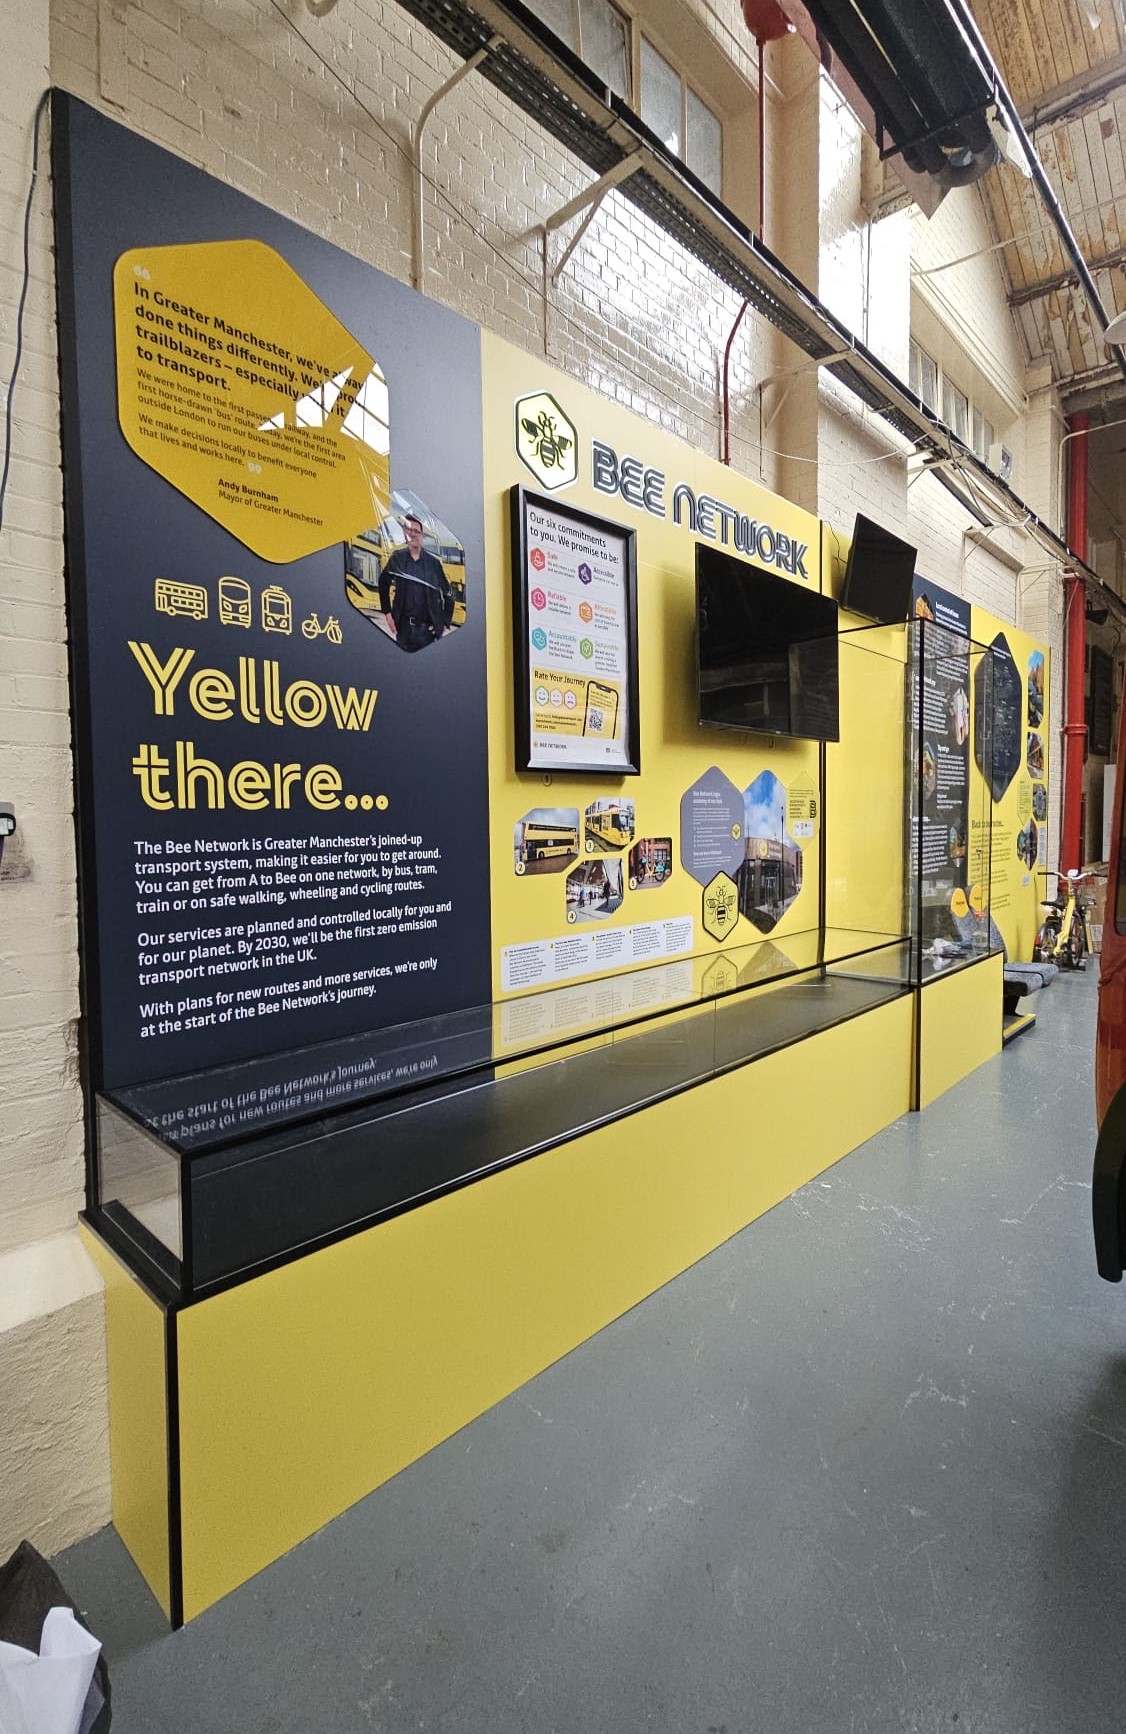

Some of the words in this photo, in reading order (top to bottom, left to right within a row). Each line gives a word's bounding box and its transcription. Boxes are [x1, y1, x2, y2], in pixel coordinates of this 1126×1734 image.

[135, 282, 149, 300] In
[153, 291, 210, 325] Greater
[213, 317, 293, 362] Manchester,
[296, 355, 330, 376] we've
[135, 304, 174, 330] done
[177, 322, 223, 351] things
[226, 343, 298, 382] differently.
[136, 325, 222, 368] trailblazers
[236, 366, 300, 402] especially
[136, 345, 153, 361] to
[157, 353, 231, 391] transport.
[137, 368, 151, 381] We
[153, 376, 175, 389] were
[177, 382, 201, 398] home
[202, 393, 212, 402] to
[213, 396, 227, 408] the
[229, 400, 244, 414] first
[137, 381, 157, 396] first
[158, 388, 213, 414] horse-drawn
[138, 395, 172, 413] outside
[174, 405, 206, 424] London
[207, 418, 217, 428] to
[218, 422, 231, 433] run
[233, 427, 247, 438] our
[248, 432, 270, 447] buses
[271, 440, 292, 454] under
[293, 448, 310, 460] local
[311, 454, 337, 469] control.
[138, 413, 153, 425] We
[155, 420, 179, 434] make
[181, 427, 220, 447] decisions
[221, 440, 246, 456] locally
[247, 449, 256, 459] to
[258, 451, 284, 468] benefit
[285, 463, 317, 479] everyone
[139, 426, 159, 440] that
[160, 432, 180, 446] lives
[181, 440, 198, 452] and
[199, 446, 223, 460] works
[225, 453, 245, 467] here.
[303, 440, 316, 451] the
[316, 444, 331, 456] first
[331, 450, 346, 461] area
[312, 433, 326, 444] and
[326, 437, 338, 448] the
[218, 477, 240, 493] Andy
[242, 485, 279, 503] Burnham
[218, 490, 242, 505] Mayor
[244, 496, 253, 507] of
[254, 500, 282, 515] Greater
[283, 508, 323, 526] Manchester
[591, 437, 666, 520] BEE
[672, 480, 809, 580] NETWORK
[529, 511, 544, 525] Our
[546, 518, 556, 530] six
[558, 524, 607, 548] commitments
[530, 527, 539, 537] to
[540, 530, 556, 542] you.
[558, 533, 570, 548] We
[571, 541, 599, 559] promise
[600, 551, 608, 561] to
[608, 552, 619, 564] be:
[127, 640, 379, 731] Yellow
[534, 670, 549, 681] Rate
[549, 672, 563, 682] Your
[564, 675, 586, 688] Journey
[132, 740, 389, 811] there...
[134, 841, 162, 855] The
[165, 840, 191, 854] Bee
[194, 838, 250, 853] Network
[252, 838, 262, 851] is
[264, 837, 307, 850] Greater
[309, 834, 377, 849] Manchester's
[377, 834, 423, 849] joined-up
[134, 858, 201, 876] transport
[204, 857, 252, 874] system,
[255, 854, 298, 869] making
[300, 853, 309, 866] it
[310, 852, 343, 865] easier
[344, 852, 359, 864] for
[360, 853, 379, 865] you
[380, 851, 390, 862] to
[392, 850, 407, 864] get
[408, 847, 441, 861] around.
[135, 880, 162, 894] You
[165, 879, 190, 892] can
[192, 877, 214, 894] get
[217, 875, 246, 889] from
[249, 873, 258, 886] A
[260, 874, 272, 885] to
[275, 871, 297, 884] Bee
[299, 872, 313, 883] on
[315, 870, 335, 881] one
[337, 866, 380, 880] network,
[382, 865, 393, 879] by
[394, 864, 414, 877] bus,
[415, 864, 438, 875] tram,
[136, 898, 170, 914] train
[173, 899, 187, 911] or
[190, 897, 207, 909] on
[210, 893, 237, 908] safe
[238, 891, 287, 905] walking,
[289, 885, 338, 900] wheeling
[339, 883, 359, 896] and
[360, 881, 393, 897] cycling
[394, 879, 425, 892] routes.
[137, 932, 165, 947] Our
[168, 927, 222, 944] services
[224, 925, 245, 937] are
[247, 917, 295, 938] planned
[296, 915, 317, 929] and
[319, 909, 371, 926] controlled
[373, 906, 403, 921] locally
[404, 904, 417, 916] for
[418, 904, 435, 917] you
[436, 900, 452, 913] and
[138, 952, 160, 967] for
[162, 950, 186, 963] our
[189, 943, 235, 963] planet.
[238, 940, 253, 955] By
[255, 935, 290, 951] 2030,
[292, 932, 319, 946] we'll
[320, 930, 334, 942] be
[335, 927, 353, 940] the
[354, 925, 375, 938] first
[376, 923, 397, 935] zero
[398, 918, 438, 933] emission
[138, 965, 205, 986] transport
[207, 956, 260, 975] network
[262, 955, 273, 967] in
[275, 952, 295, 966] the
[297, 948, 318, 962] UK.
[139, 1000, 174, 1018] With
[177, 995, 213, 1016] plans
[216, 991, 234, 1006] for
[236, 988, 262, 1001] new
[264, 980, 300, 997] routes
[302, 975, 322, 990] and
[324, 972, 351, 986] more
[352, 966, 393, 982] services,
[394, 960, 418, 974] we're
[419, 957, 438, 971] only
[140, 1024, 155, 1038] at
[158, 1019, 182, 1034] the
[184, 1012, 217, 1029] start
[219, 1008, 233, 1023] of
[234, 1005, 255, 1020] the
[257, 1001, 280, 1015] Bee
[282, 989, 336, 1010] Network's
[336, 984, 377, 1004] journey.
